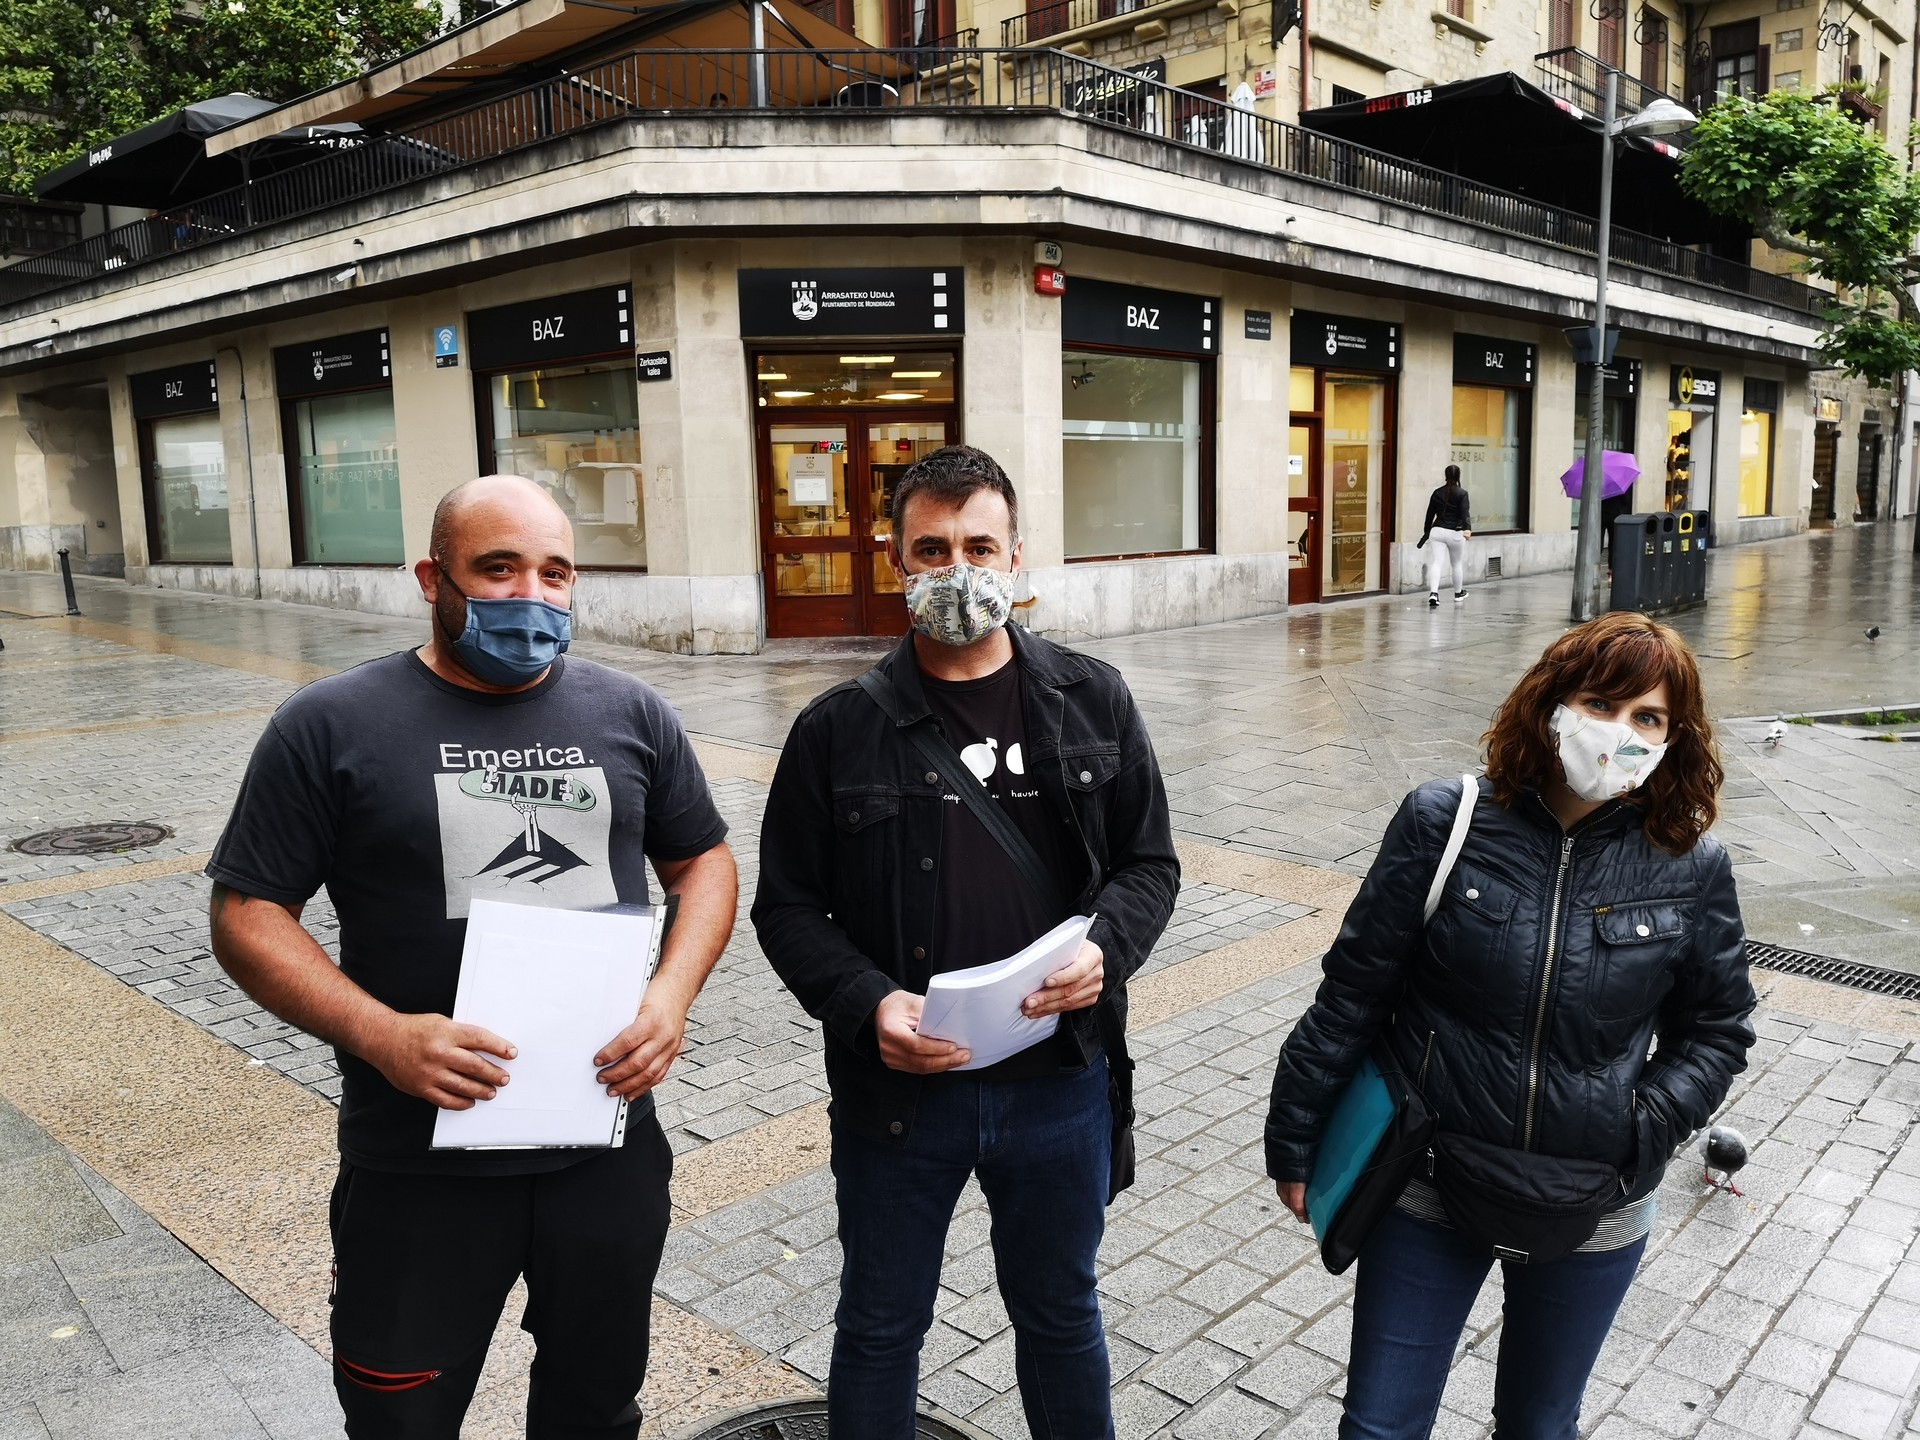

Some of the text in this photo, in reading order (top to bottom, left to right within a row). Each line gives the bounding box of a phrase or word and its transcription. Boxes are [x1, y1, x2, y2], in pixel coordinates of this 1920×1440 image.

[821, 291, 895, 300] ARRASATEKO UDALA
[1126, 305, 1160, 330] BAZ
[532, 316, 565, 341] BAZ
[639, 356, 668, 367] Zerkaosteta
[1485, 351, 1504, 369] BAZ
[647, 367, 661, 376] kalea
[165, 380, 184, 398] BAZ
[387, 468, 399, 481] BA
[439, 742, 595, 768] Emerica.
[483, 770, 570, 801] MADE
